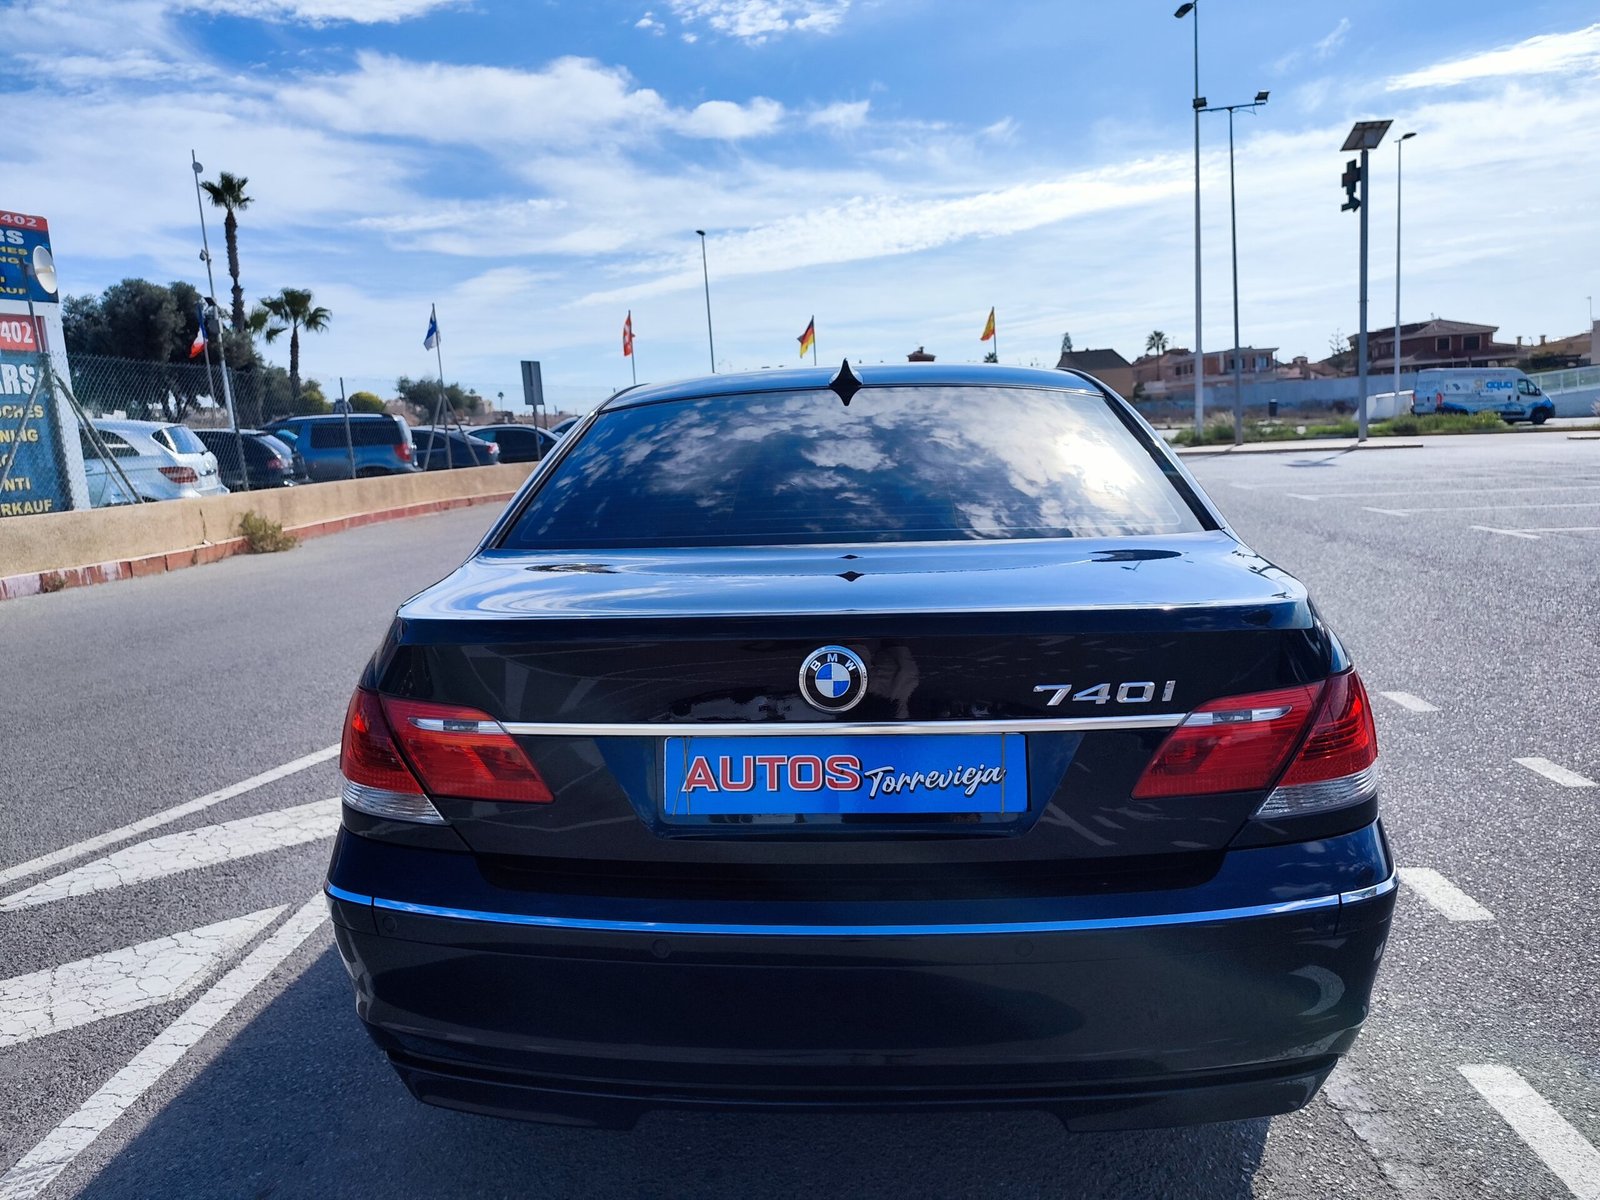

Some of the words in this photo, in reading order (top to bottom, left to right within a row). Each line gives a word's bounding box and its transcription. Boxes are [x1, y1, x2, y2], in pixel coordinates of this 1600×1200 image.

[1, 214, 37, 227] 402
[1, 320, 32, 342] 402
[1486, 381, 1513, 390] aqua
[810, 653, 857, 671] BMW
[682, 754, 862, 793] AUTOS
[864, 764, 1006, 798] Torrevieja
